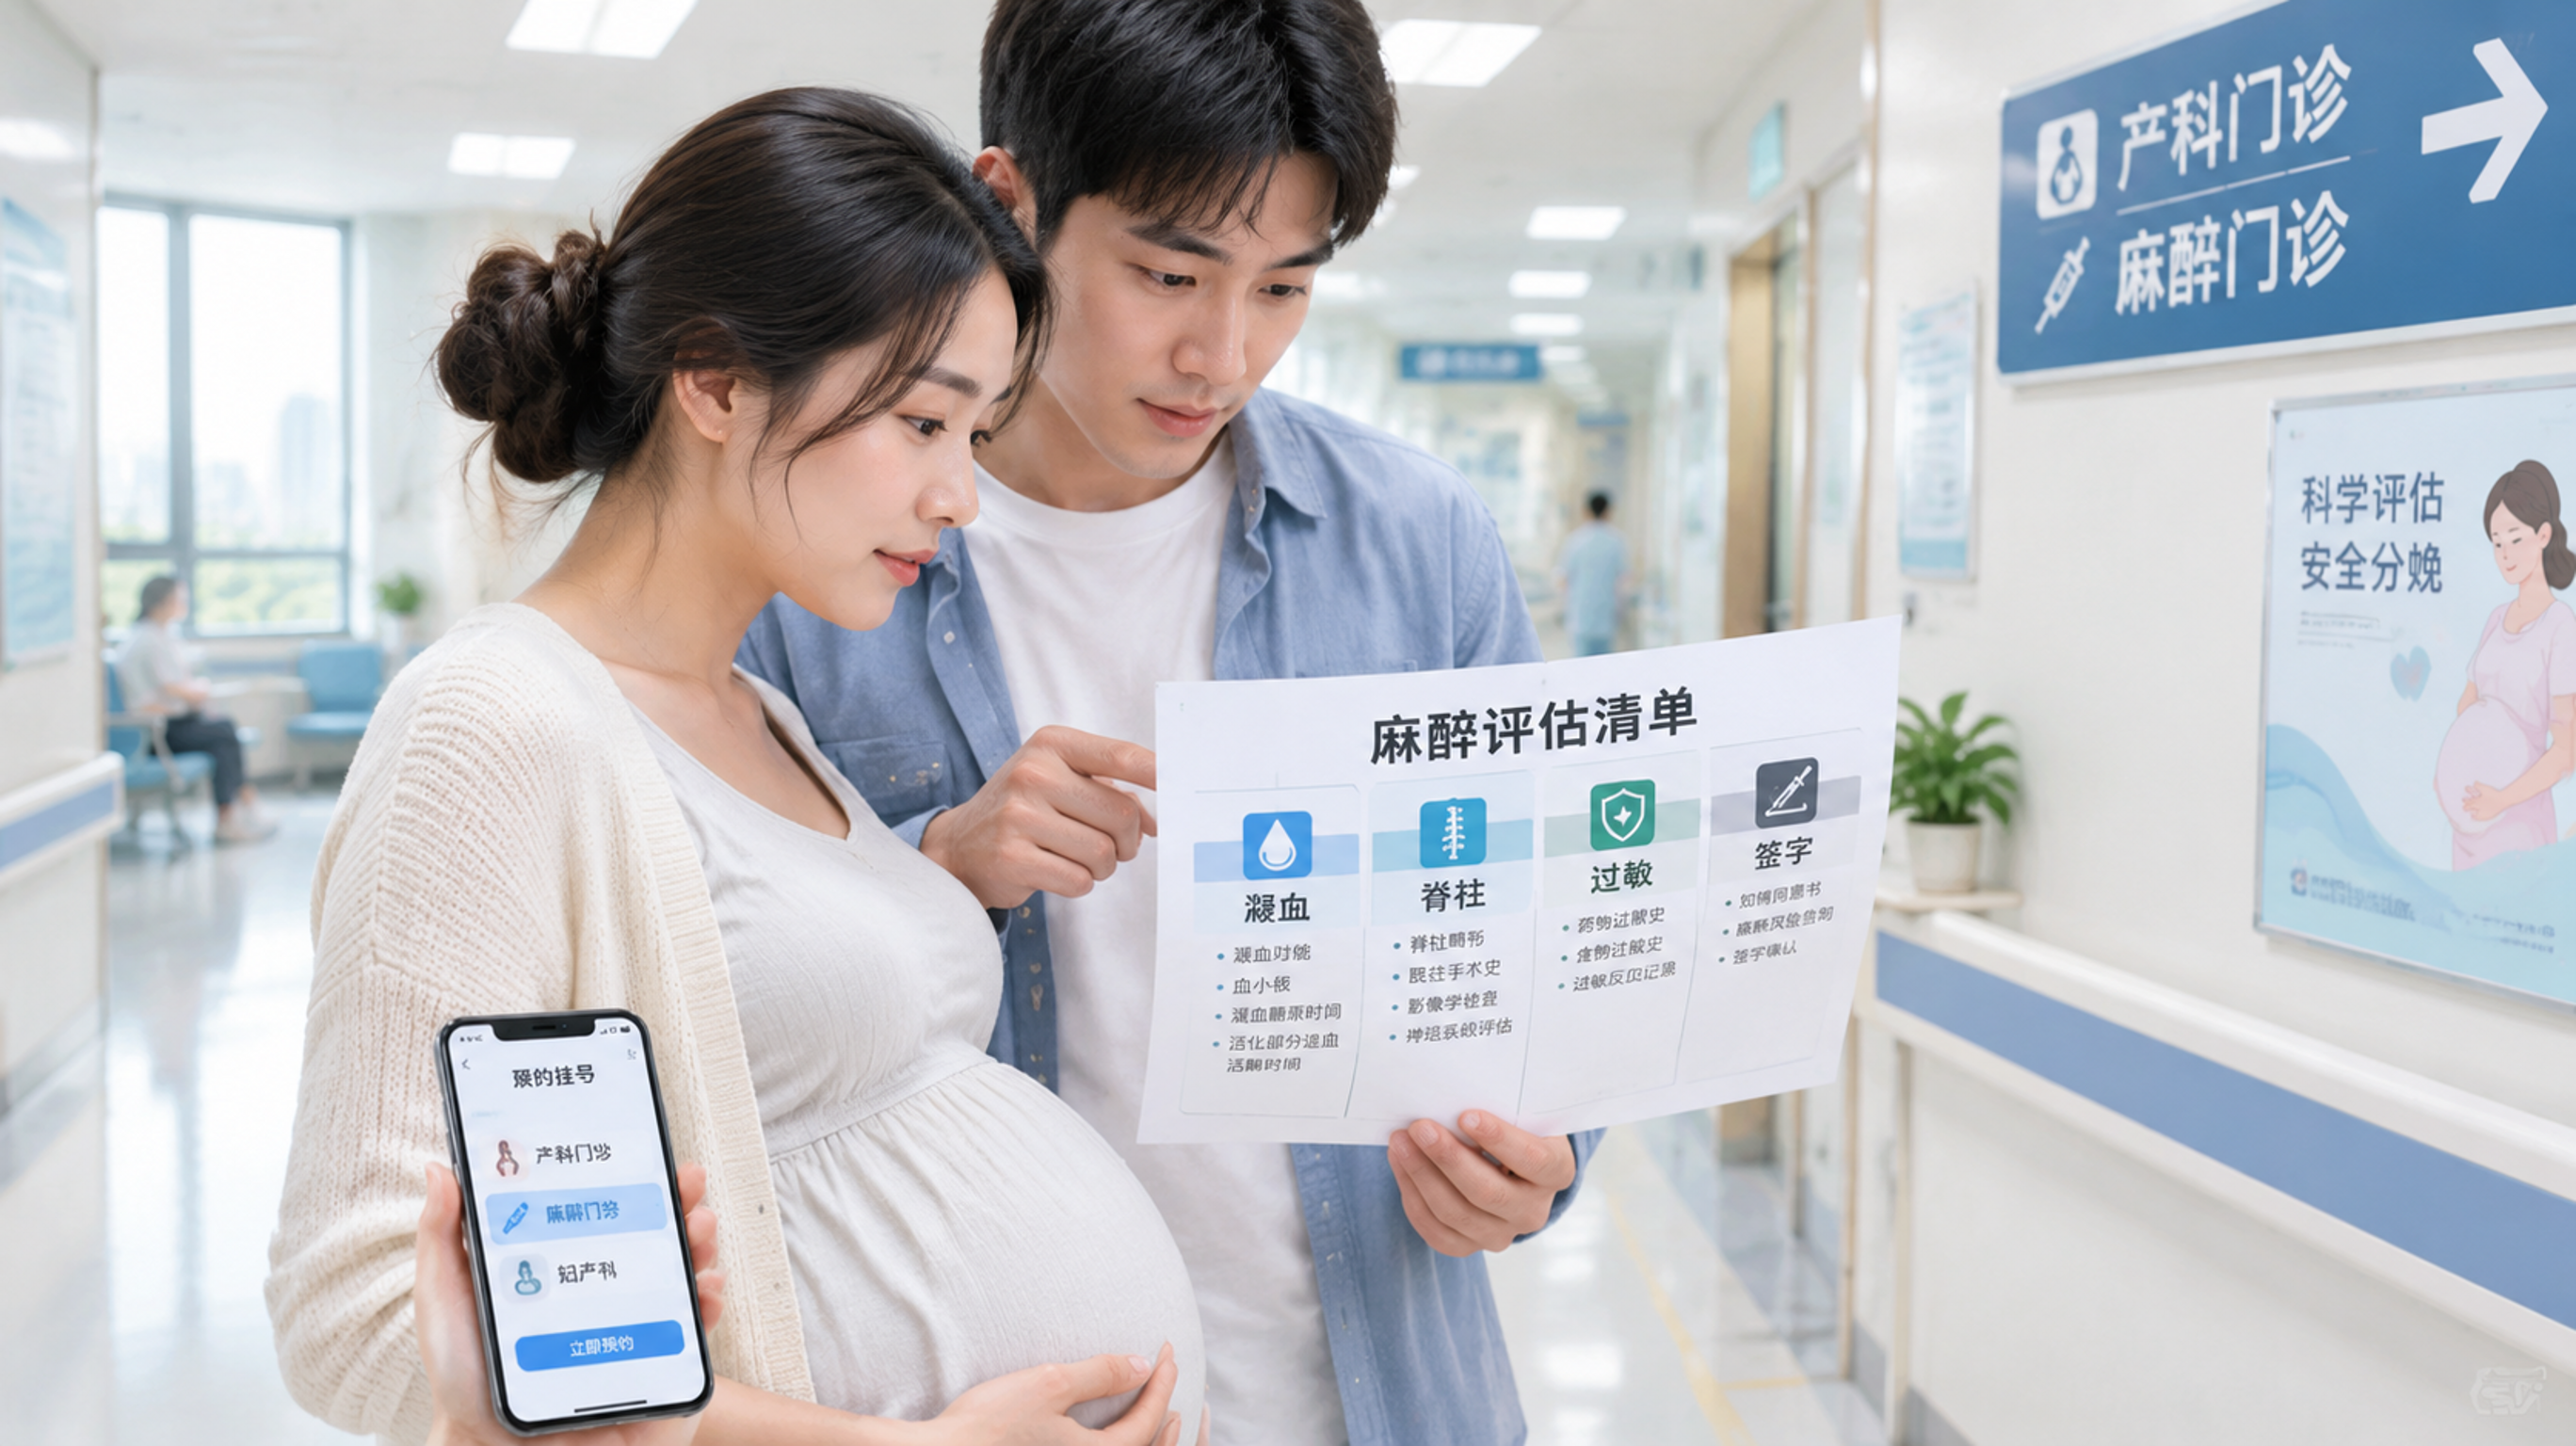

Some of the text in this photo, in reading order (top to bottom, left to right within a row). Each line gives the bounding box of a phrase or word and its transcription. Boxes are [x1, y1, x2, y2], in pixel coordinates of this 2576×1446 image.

[2117, 43, 2352, 192] 产科门诊
[2115, 189, 2349, 315] 麻醉门诊
[2301, 471, 2445, 524] 科学评估
[1370, 685, 1698, 765] 麻醉评估清单
[1421, 877, 1486, 913] 脊柱
